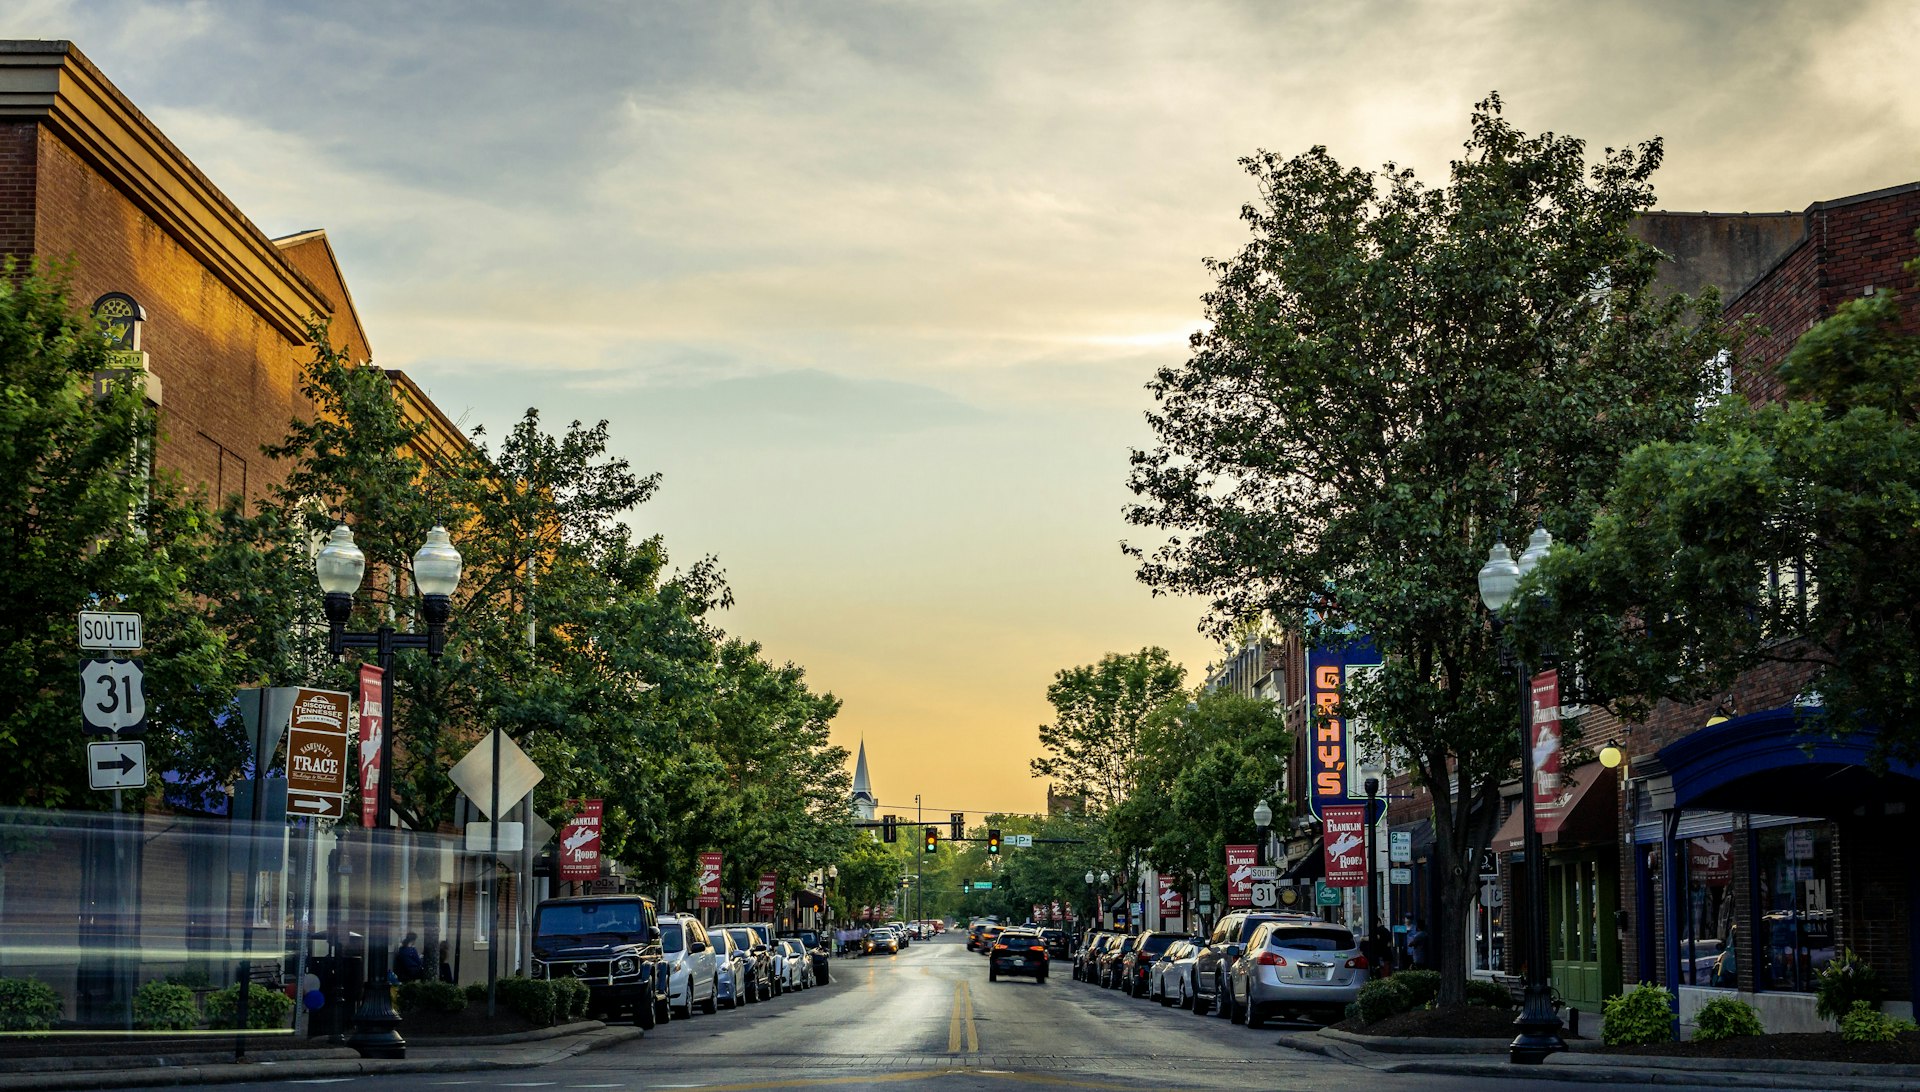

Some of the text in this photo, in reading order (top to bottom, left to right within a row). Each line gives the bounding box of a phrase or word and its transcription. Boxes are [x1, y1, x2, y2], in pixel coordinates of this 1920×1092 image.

[84, 620, 137, 641] SOUTH
[96, 674, 132, 714] 31
[295, 705, 343, 720] TENNESSEE
[302, 701, 337, 711] DISCOVER
[293, 755, 339, 774] TRACE
[569, 816, 599, 826] RANKLIN
[1326, 819, 1362, 833] FRANKLIN
[1392, 833, 1398, 843] 2
[574, 848, 598, 863] RODEO
[1229, 854, 1255, 866] FRANKLIN
[1340, 854, 1363, 869] RODEO
[1252, 869, 1276, 878] SOUTH
[1256, 887, 1272, 902] 31
